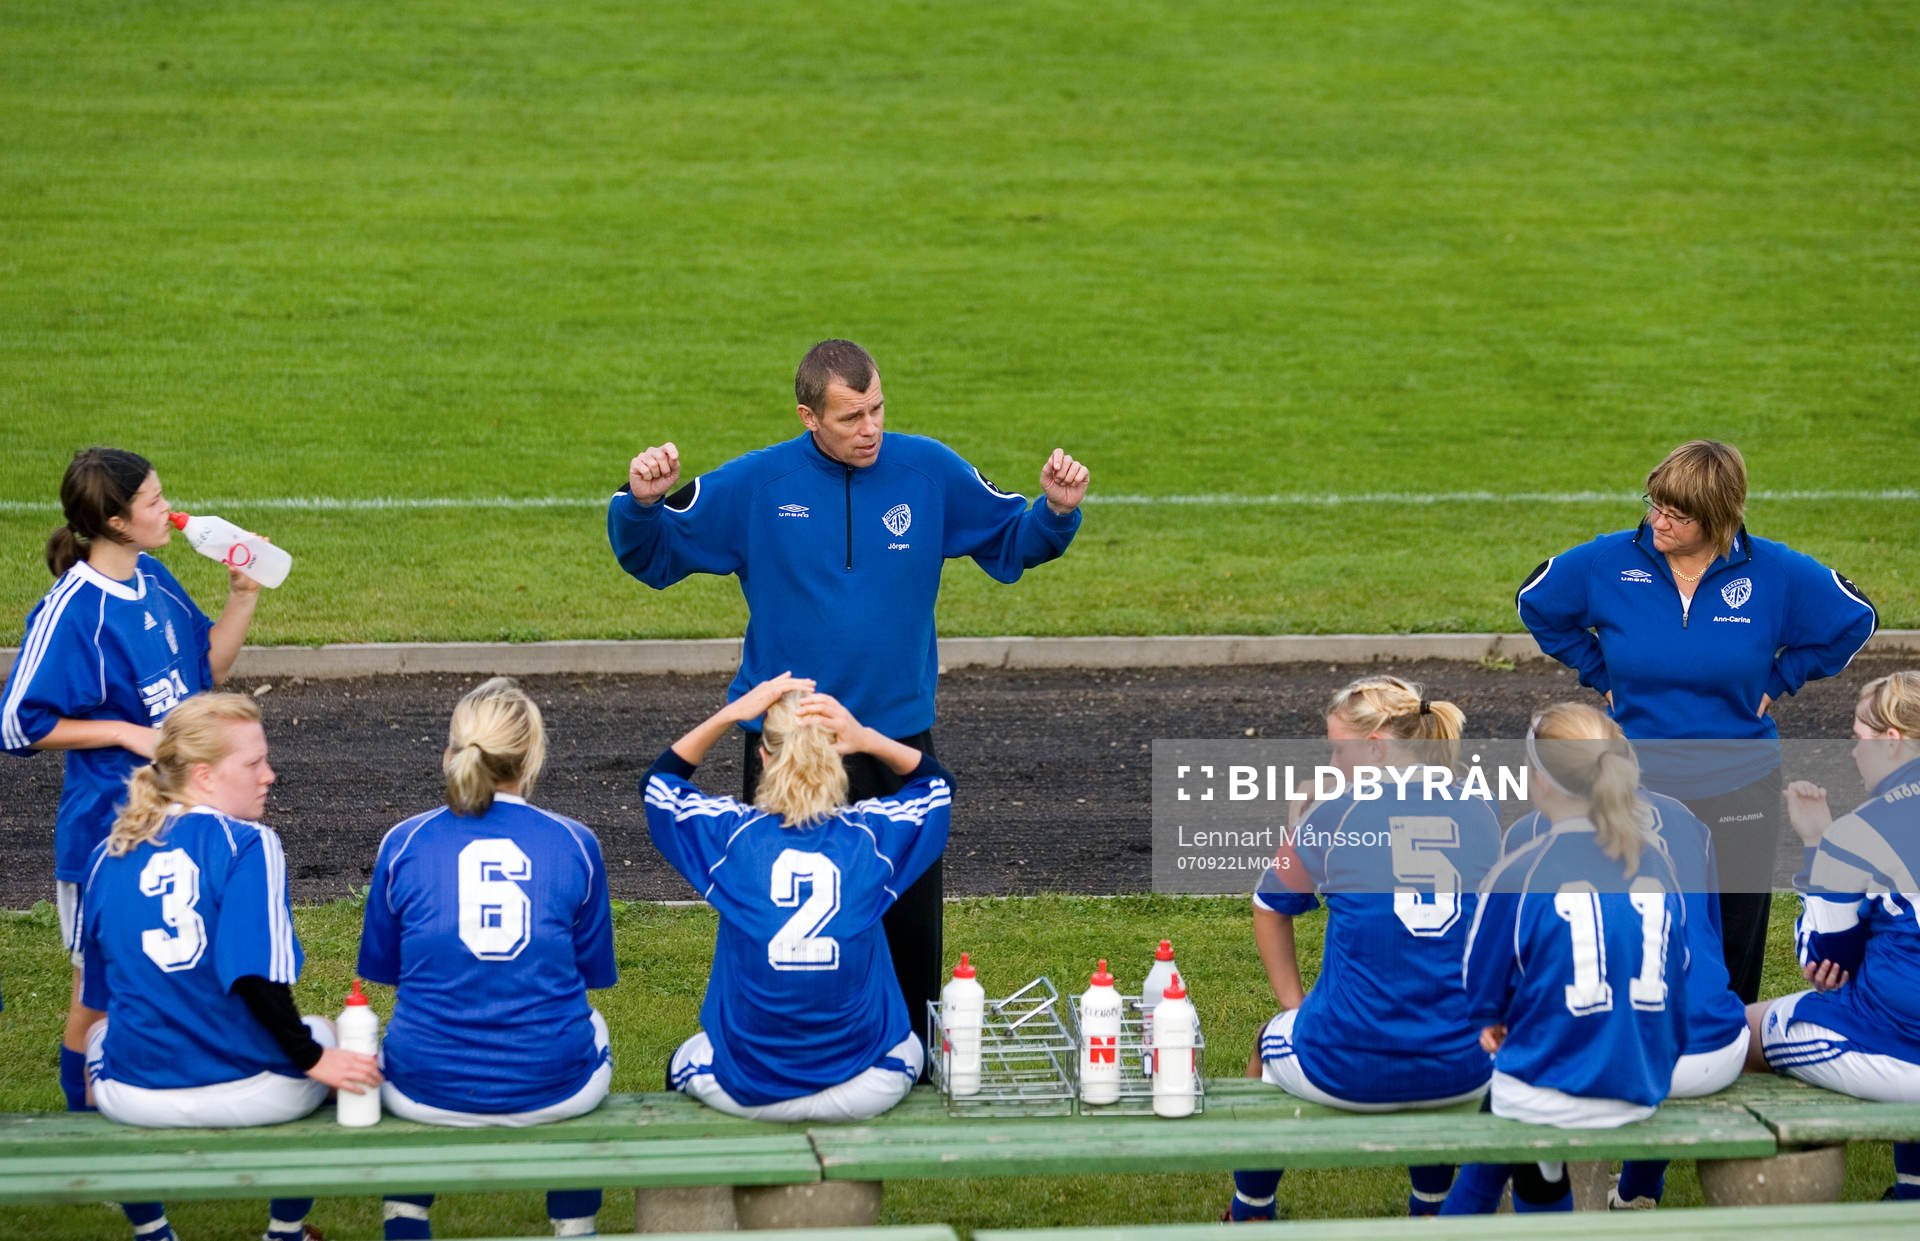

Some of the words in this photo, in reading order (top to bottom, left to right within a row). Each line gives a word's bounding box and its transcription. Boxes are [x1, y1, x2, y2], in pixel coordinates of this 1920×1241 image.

[887, 542, 910, 551] Jörgen
[1712, 615, 1751, 624] Ann-Carina
[1388, 815, 1462, 938] 5
[1718, 811, 1765, 824] ANN-CARINA
[139, 847, 208, 973] 3
[458, 837, 532, 961] 6
[768, 847, 841, 972] 2
[1553, 875, 1672, 1018] 11
